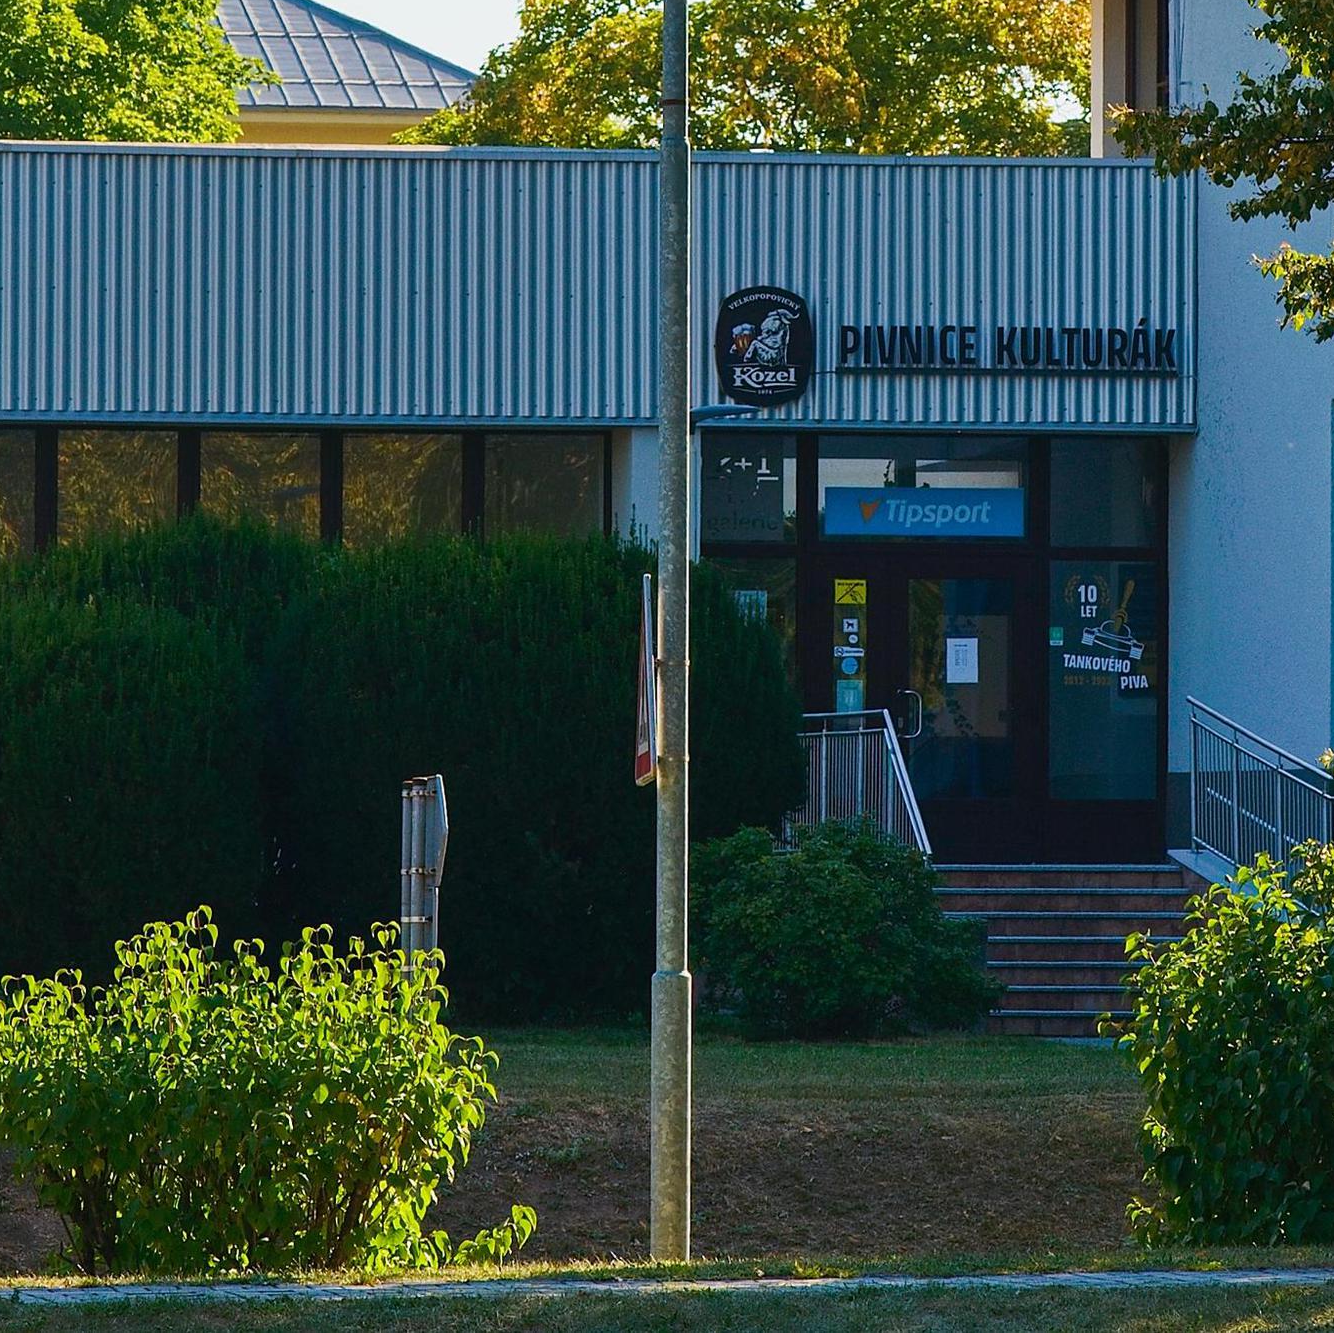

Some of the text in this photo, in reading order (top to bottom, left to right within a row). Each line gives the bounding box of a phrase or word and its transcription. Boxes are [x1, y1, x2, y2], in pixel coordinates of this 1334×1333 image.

[840, 318, 1176, 367] PIVNICE KULTURÁK
[732, 367, 797, 388] Kozel
[886, 499, 991, 528] Tipsport
[1078, 585, 1098, 603] 10
[1081, 605, 1098, 618] LET
[1063, 654, 1131, 673] TANKOVÉHO
[1120, 675, 1149, 689] PIVA
